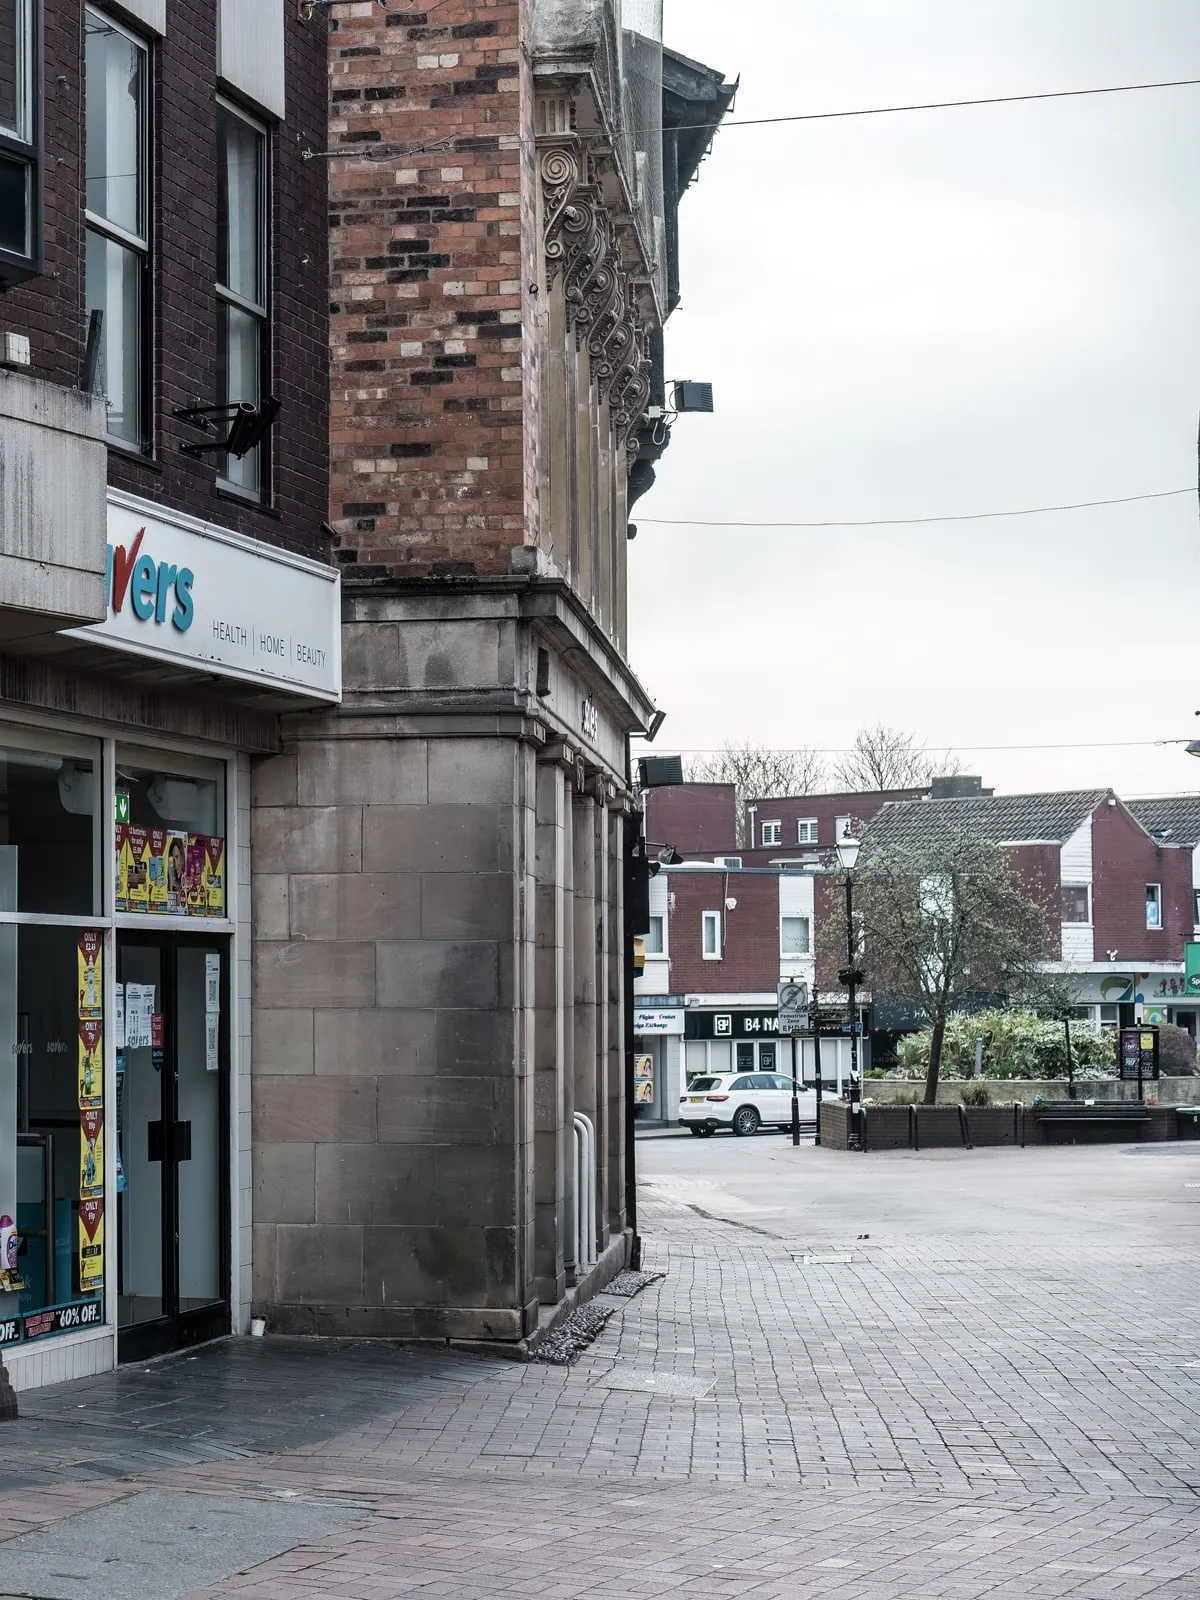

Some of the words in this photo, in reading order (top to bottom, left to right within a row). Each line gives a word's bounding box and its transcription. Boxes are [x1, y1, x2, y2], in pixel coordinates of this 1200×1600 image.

[105, 527, 194, 632] vers
[212, 620, 247, 647] HEALTH
[260, 634, 285, 658] HOME
[296, 644, 327, 668] BEAUTY
[85, 932, 97, 942] ONLY
[85, 1022, 97, 1031] ONLY
[744, 1017, 761, 1032] B4
[85, 1111, 98, 1121] ONLY
[85, 1200, 99, 1211] ONLY
[59, 1307, 80, 1328] 60%
[81, 1304, 97, 1323] OFF
